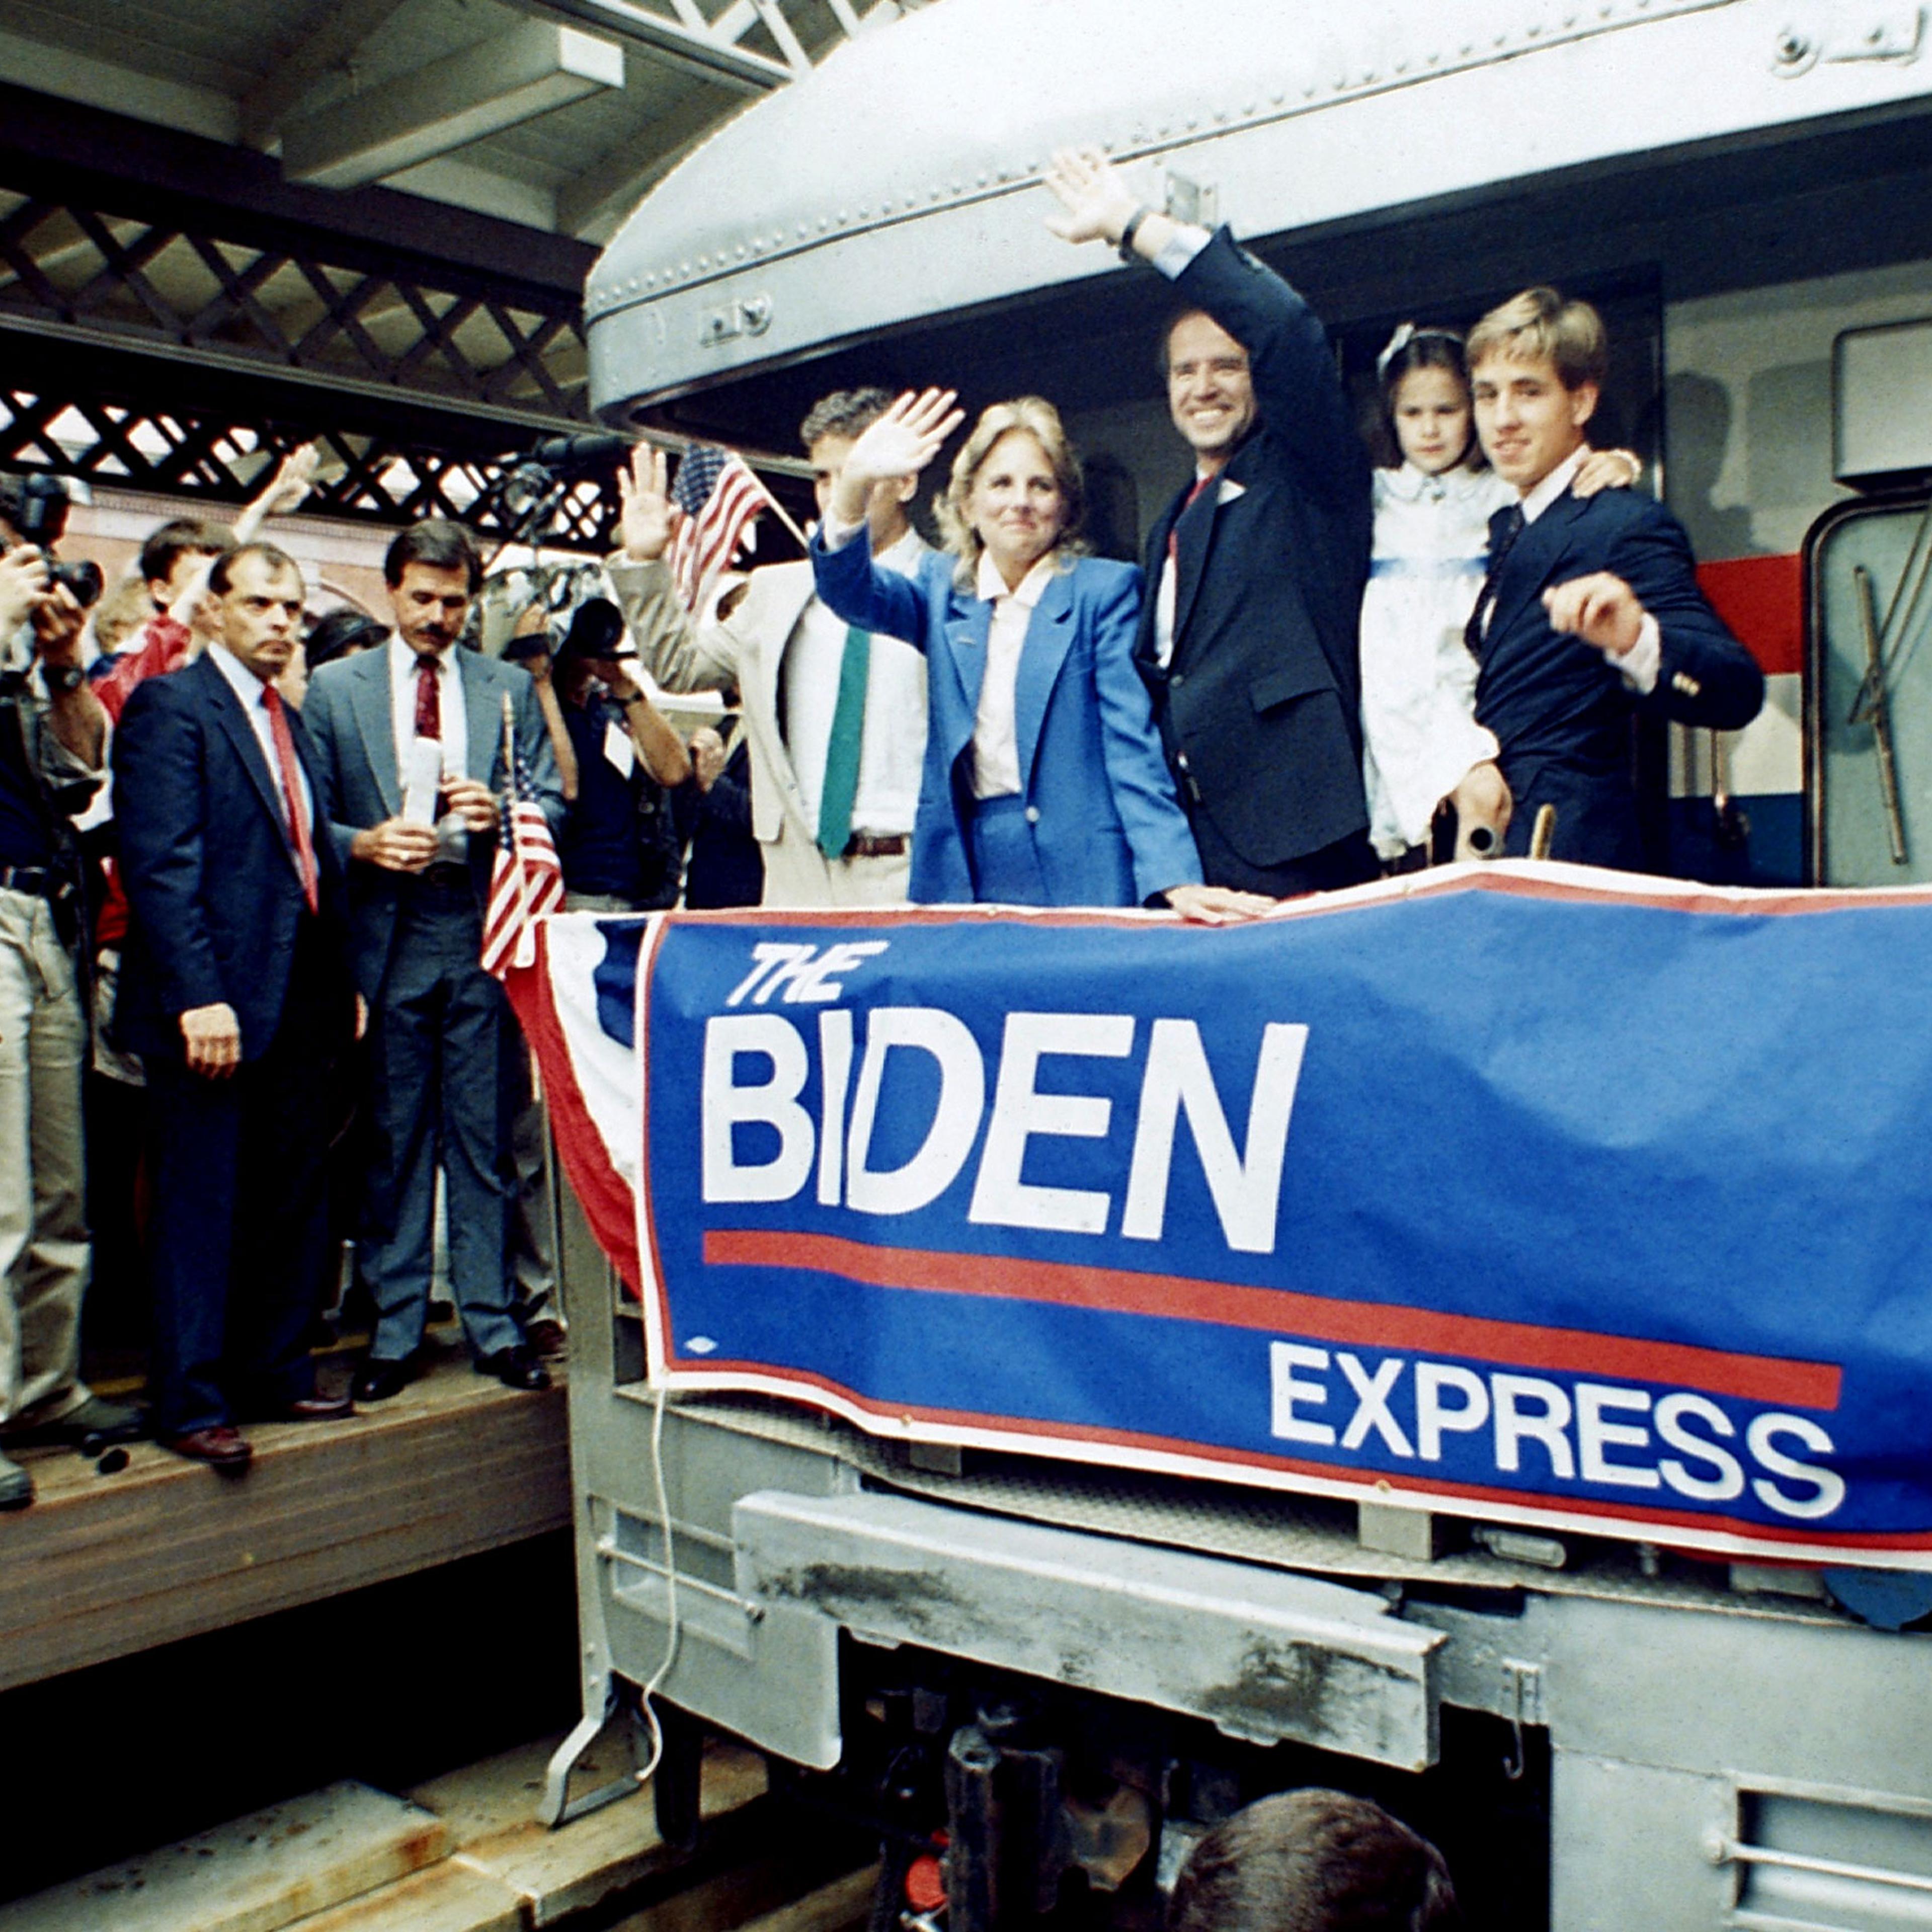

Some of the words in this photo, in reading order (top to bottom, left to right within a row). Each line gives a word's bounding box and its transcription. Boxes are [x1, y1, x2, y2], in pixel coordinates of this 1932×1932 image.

[726, 940, 890, 1006] THE
[702, 1006, 1309, 1254] BIDEN
[1270, 1340, 1845, 1519] EXPRESS
